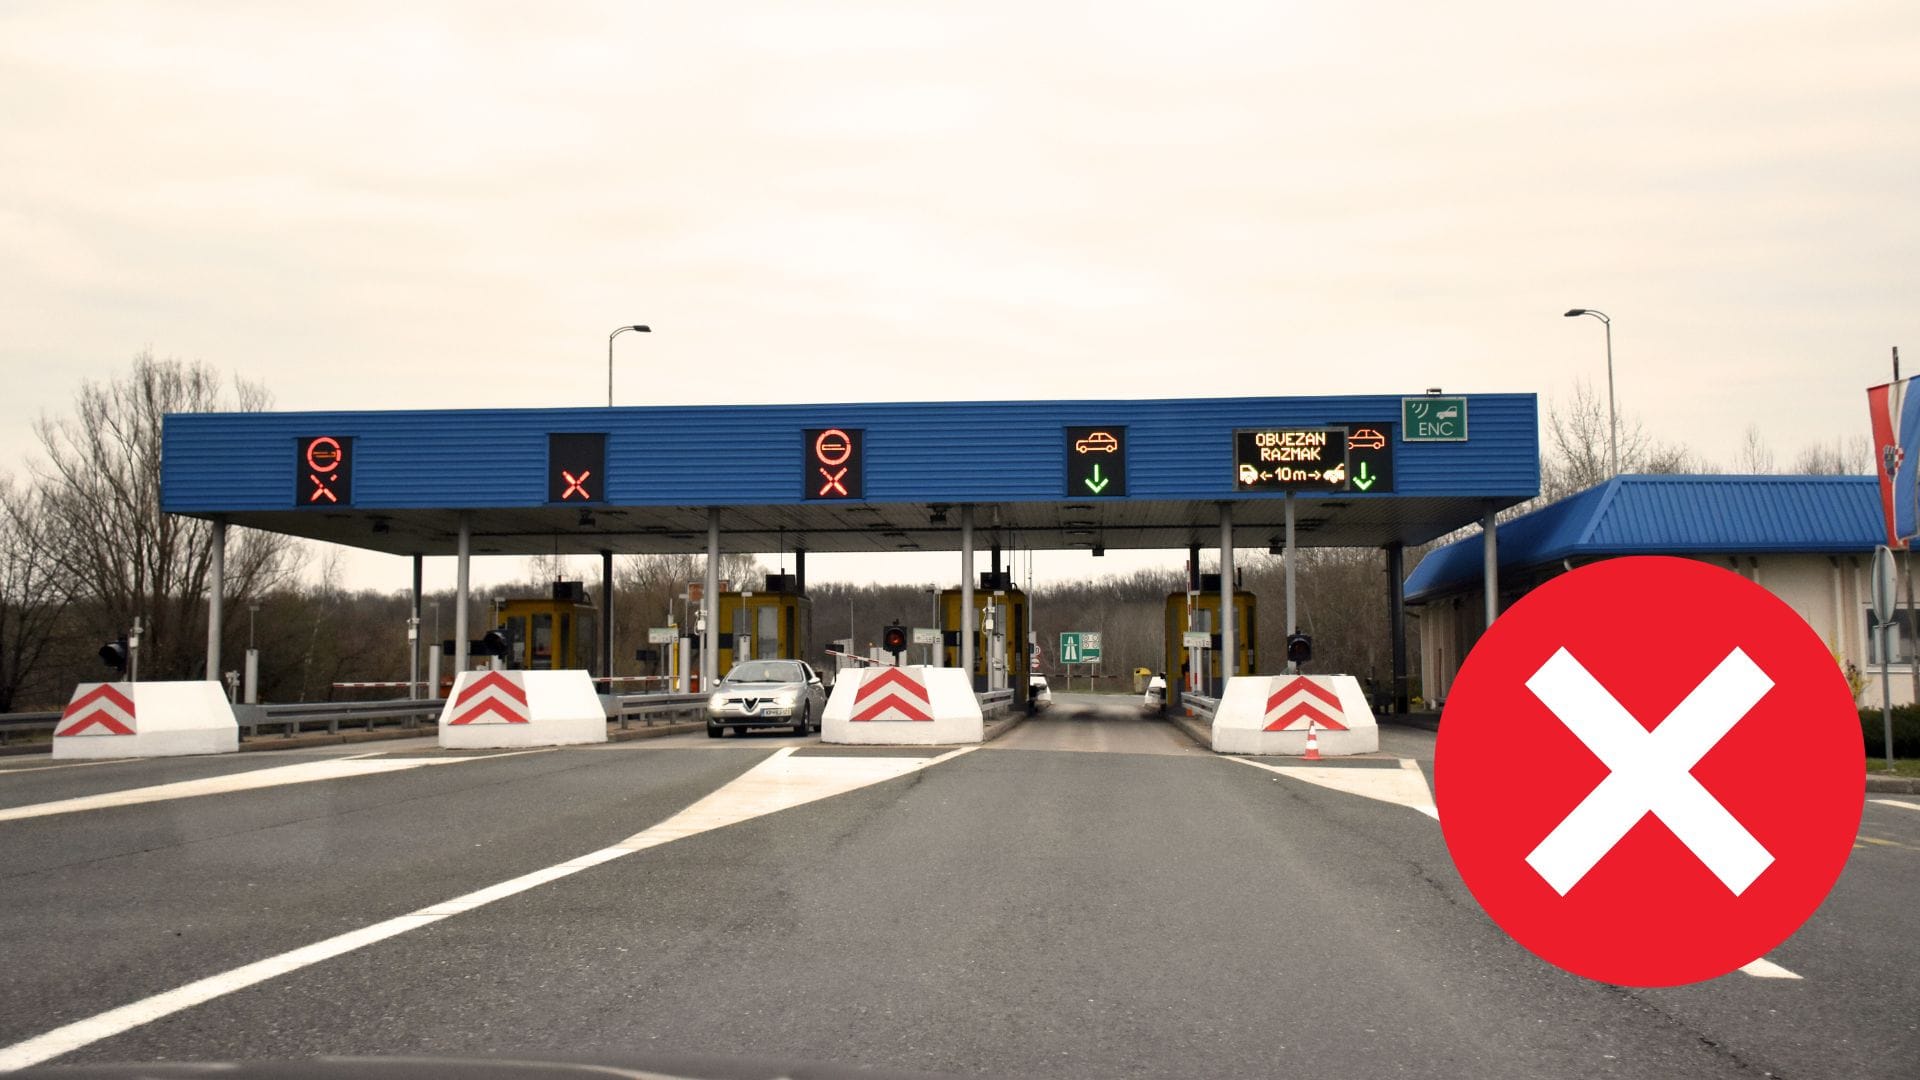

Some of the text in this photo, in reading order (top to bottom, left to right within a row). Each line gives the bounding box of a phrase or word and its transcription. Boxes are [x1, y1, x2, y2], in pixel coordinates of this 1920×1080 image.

[1419, 421, 1454, 436] ENC
[1256, 432, 1326, 446] OBVEZAN
[1261, 447, 1321, 461] RAZMAK
